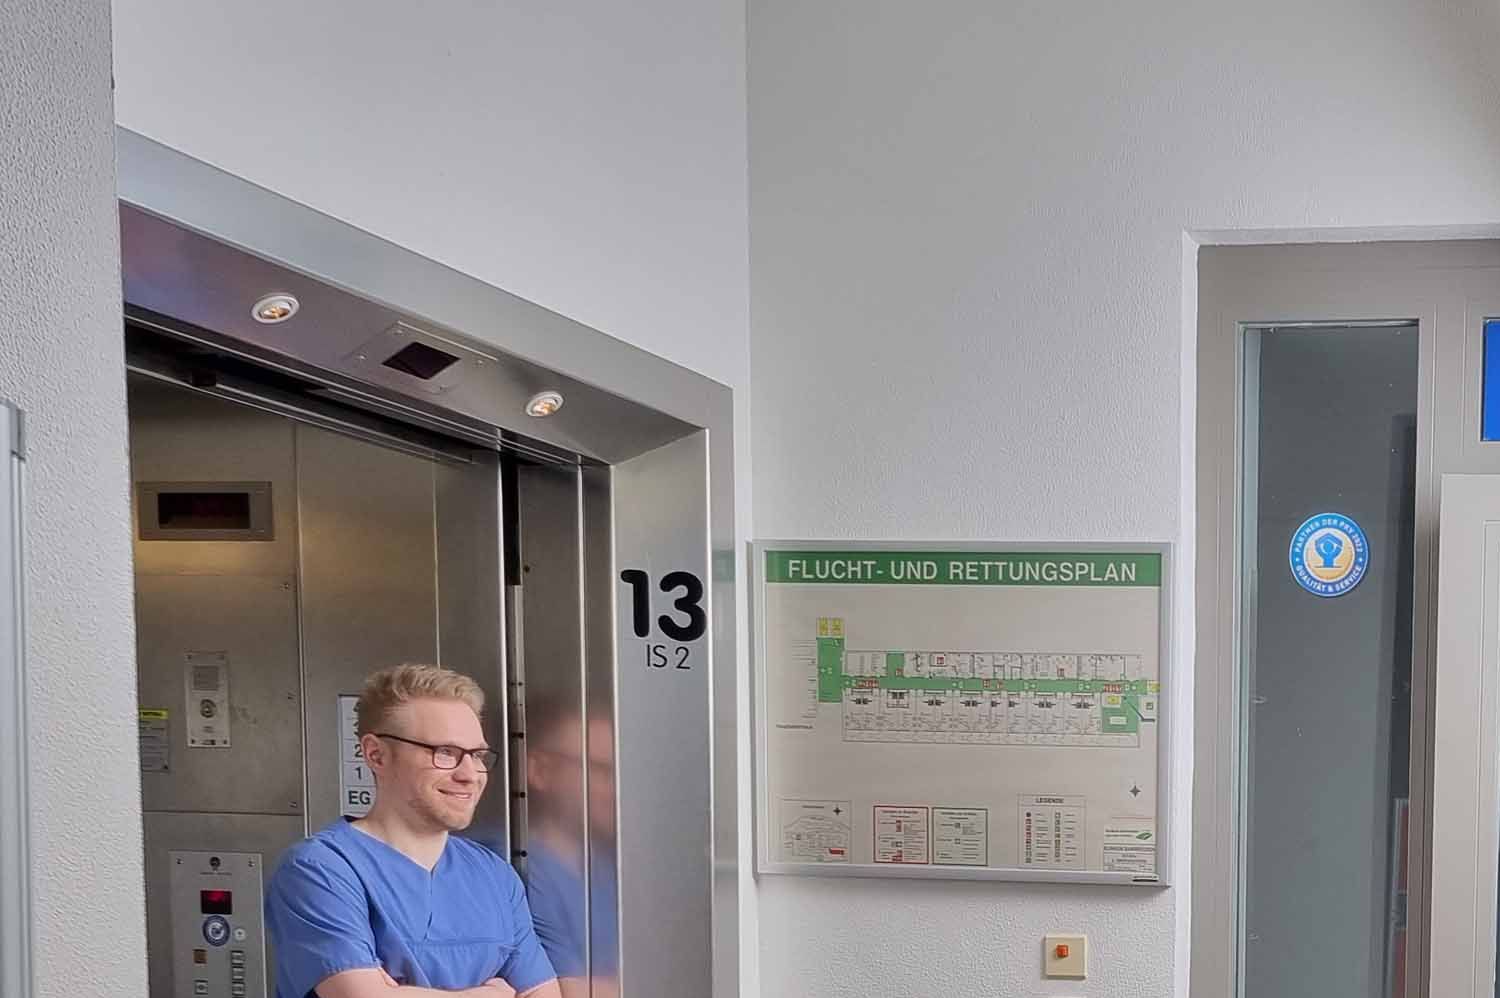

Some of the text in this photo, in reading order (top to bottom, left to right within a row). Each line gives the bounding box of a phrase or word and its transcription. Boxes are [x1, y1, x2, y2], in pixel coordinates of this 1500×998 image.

[788, 560, 1137, 582] FLUCHT- UND RETTUNGSPLAN
[1335, 565, 1362, 592] SERVICE
[620, 569, 707, 642] 13
[647, 644, 691, 670] IS 2
[354, 744, 363, 758] 2
[355, 767, 363, 780] 1
[348, 791, 371, 805] EG
